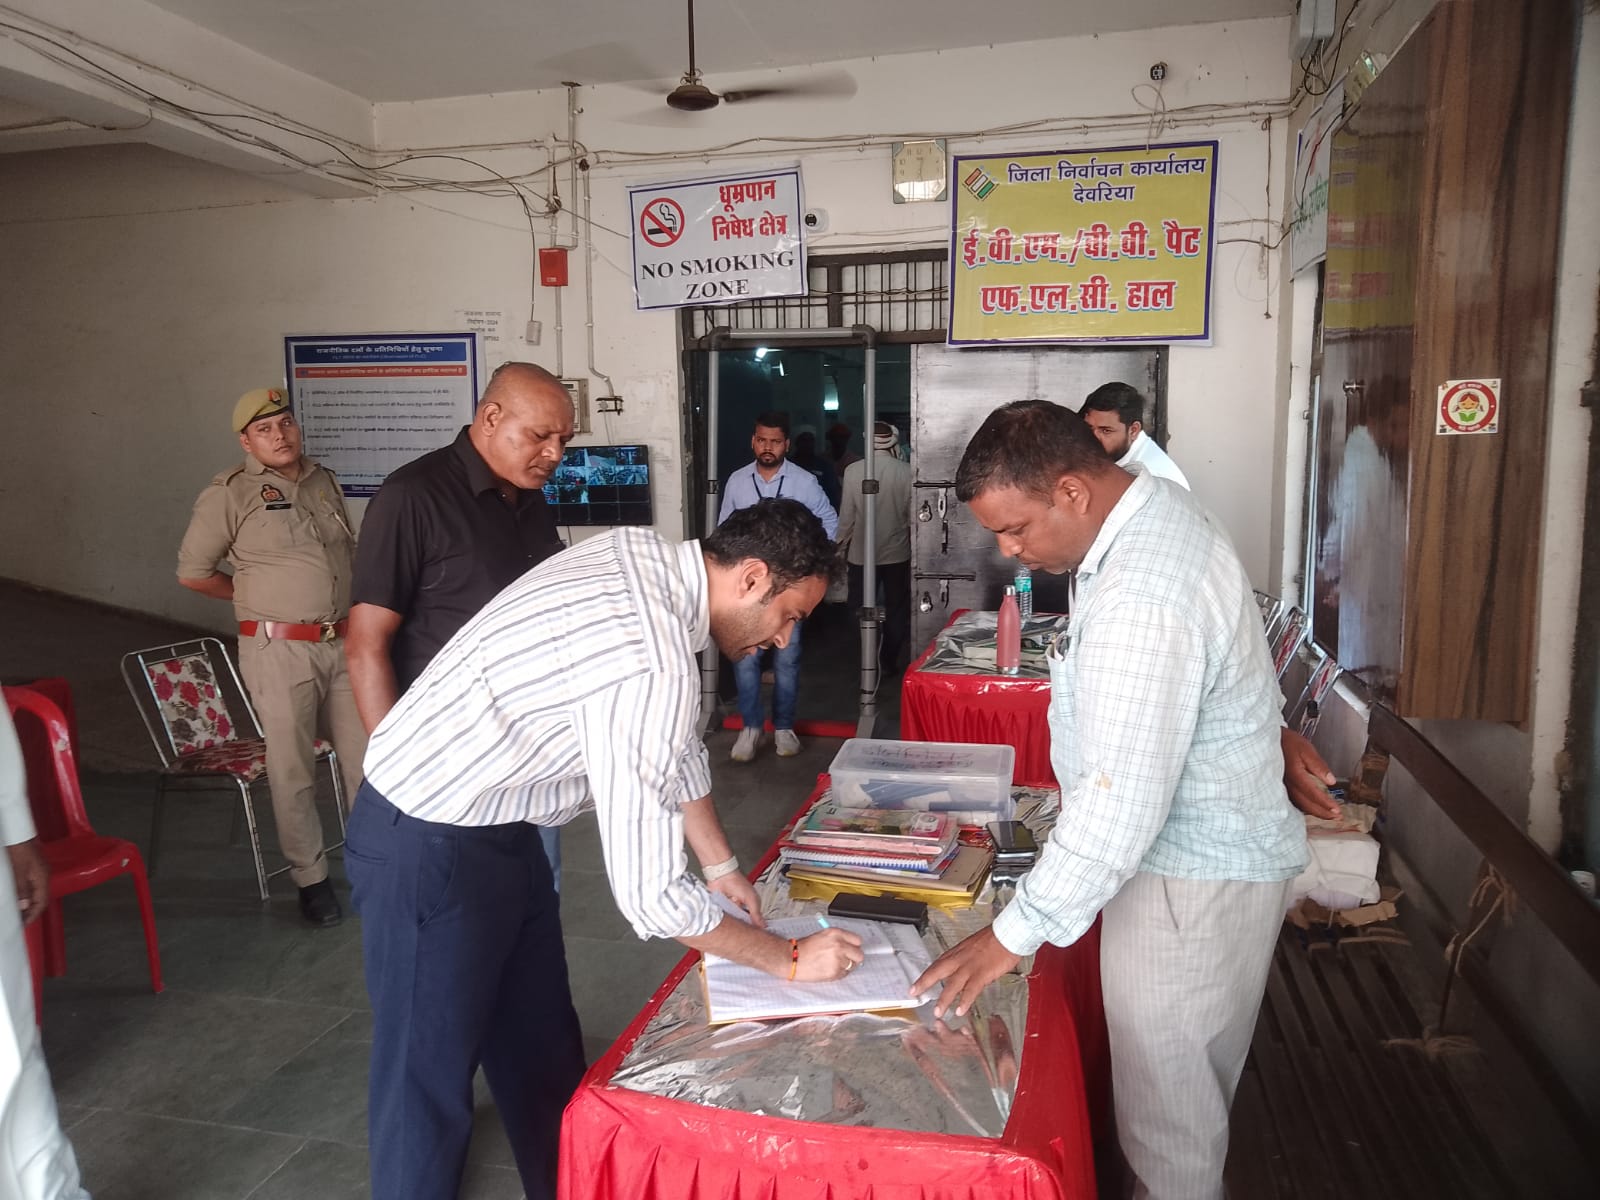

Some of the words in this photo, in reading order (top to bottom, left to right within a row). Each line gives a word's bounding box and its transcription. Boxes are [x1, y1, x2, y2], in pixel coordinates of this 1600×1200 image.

[1008, 163, 1051, 183] जिला
[1058, 158, 1124, 180] निर्वाचन
[1130, 153, 1207, 176] कार्यालय
[719, 180, 777, 212] धूम्रपान
[1073, 183, 1135, 203] देवरिया
[712, 213, 755, 242] निषेध
[759, 211, 788, 237] क्षेत्र
[1164, 220, 1202, 255] पैट
[641, 262, 674, 280] NO
[680, 250, 797, 277] SMOKING
[686, 279, 750, 300] ZONE
[1127, 281, 1177, 310] हाल
